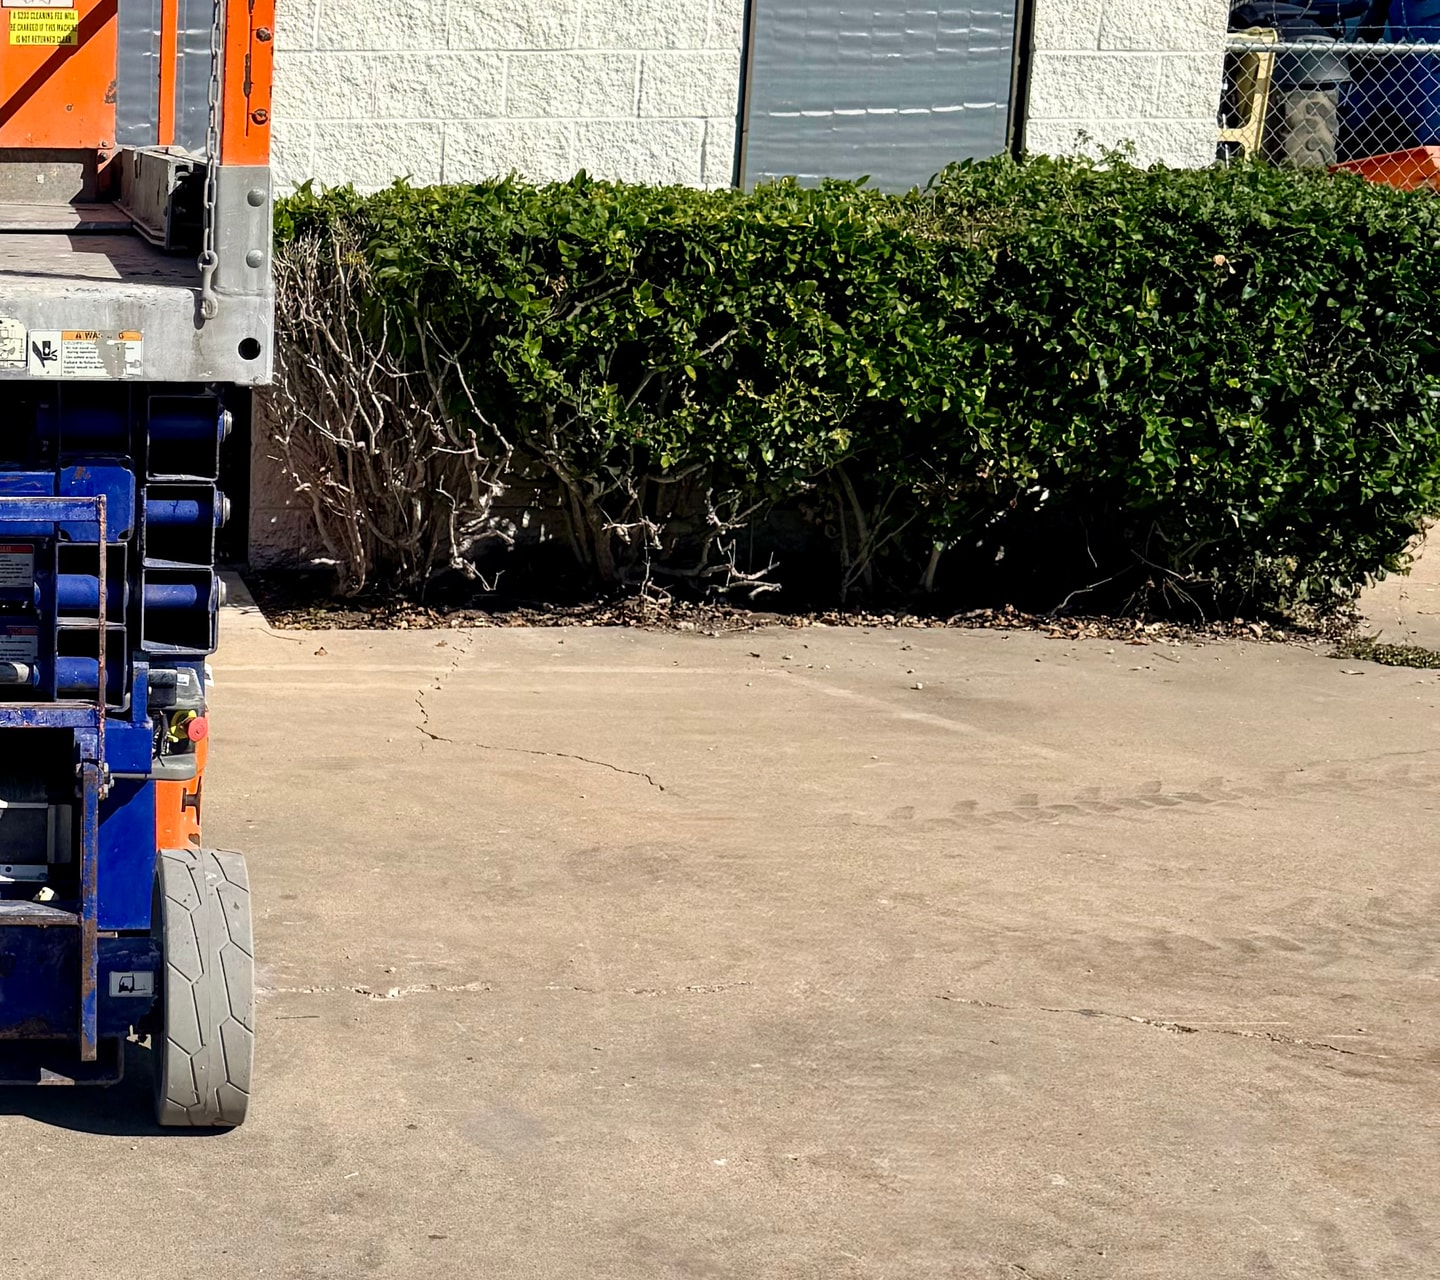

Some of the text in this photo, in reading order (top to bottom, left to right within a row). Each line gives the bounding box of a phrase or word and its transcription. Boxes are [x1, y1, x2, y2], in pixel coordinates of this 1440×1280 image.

[30, 11, 53, 20] CLEANING
[54, 11, 63, 20] FEE
[64, 11, 75, 20] WILL
[17, 23, 38, 31] CHARGED
[45, 23, 55, 31] THIS
[56, 23, 78, 32] MACHINE
[21, 35, 30, 43] NOT
[31, 35, 55, 43] RETURNED
